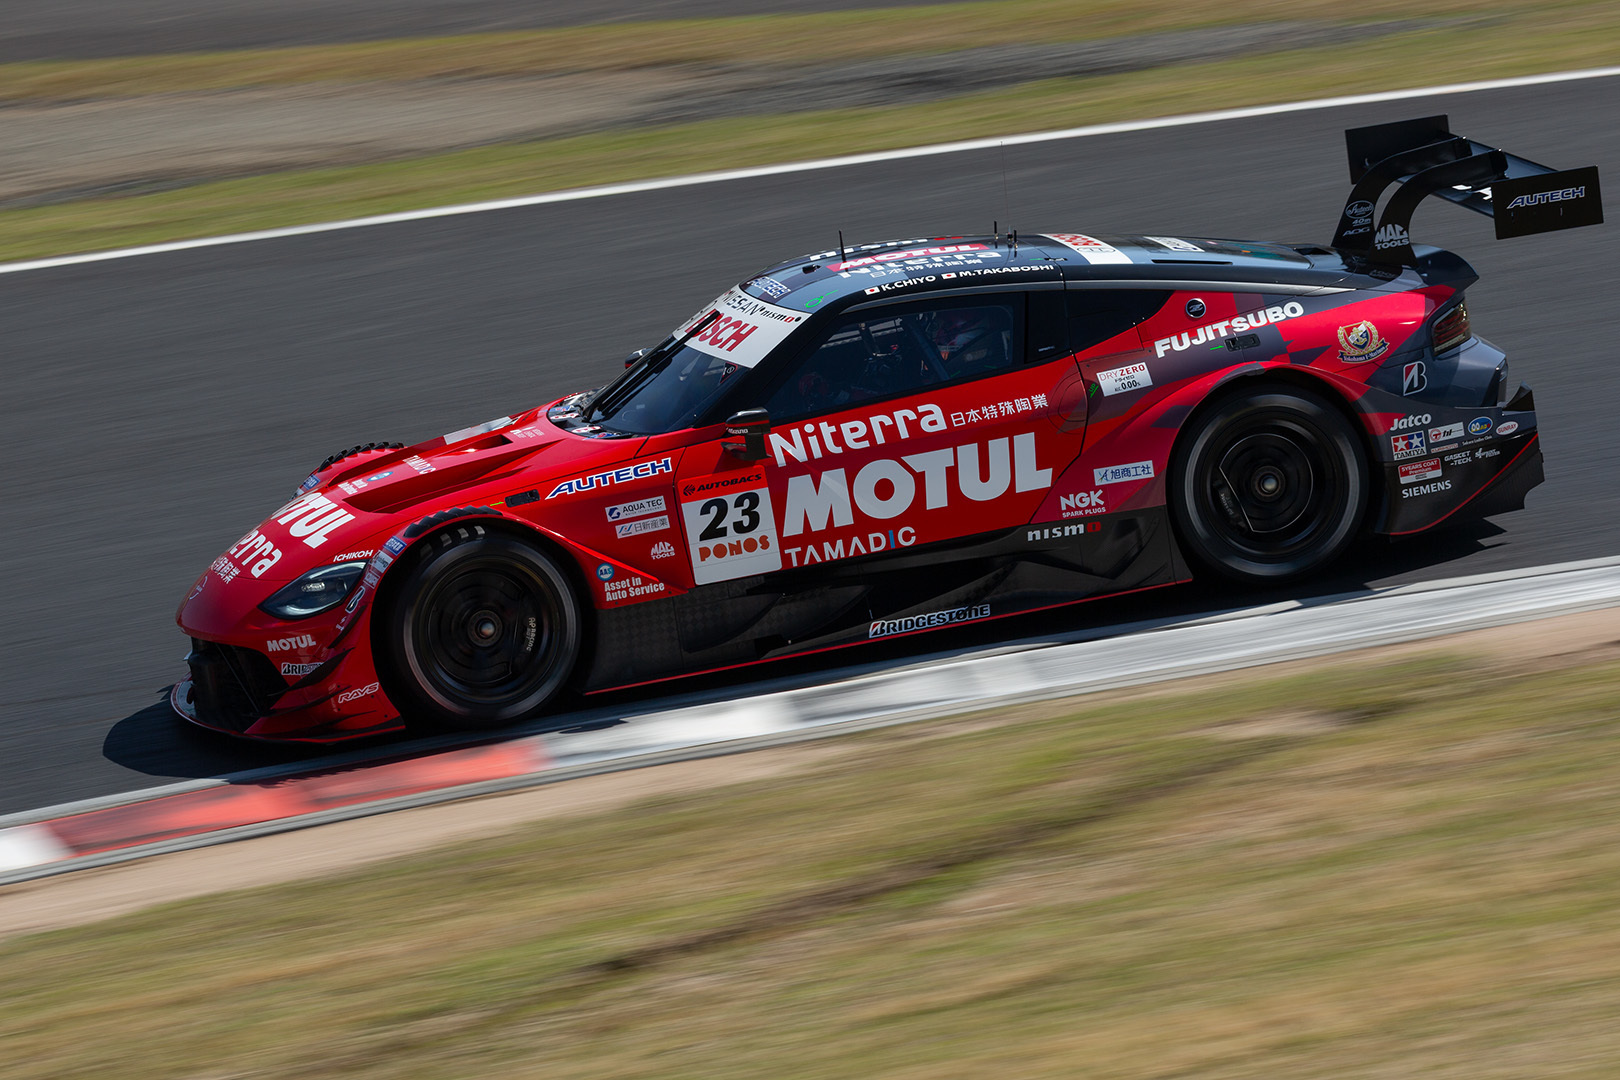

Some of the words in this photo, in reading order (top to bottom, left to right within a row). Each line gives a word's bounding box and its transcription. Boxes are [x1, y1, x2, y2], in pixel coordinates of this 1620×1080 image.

[1507, 186, 1585, 209] AUTECH
[1375, 224, 1409, 244] MAC
[1375, 239, 1410, 250] TOOLS
[839, 243, 980, 269] MOTUL
[881, 275, 937, 291] K.CHIYO
[959, 265, 1055, 278] M.TAKABOSHI
[1154, 301, 1304, 358] FUJITSUBO
[769, 403, 947, 467] Niterra
[951, 393, 1048, 427] 日本特殊陶業
[1390, 413, 1432, 431] Jatco
[1394, 448, 1426, 460] TAMIYA
[545, 457, 672, 500] AUTECH
[696, 473, 762, 492] AUTOBACS
[1110, 465, 1152, 480] 旭商工社
[783, 432, 1053, 537] MOTUL
[1402, 480, 1452, 499] SIEMENS
[622, 502, 646, 513] AQUA
[1060, 489, 1105, 510] NGK
[271, 490, 355, 549] OTUL
[699, 491, 761, 542] 23
[1062, 510, 1084, 518] SPARK
[1085, 507, 1106, 515] PLUGS
[1027, 521, 1101, 542] nismo
[333, 550, 373, 562] ICHIKOH
[651, 541, 675, 555] MAC
[651, 551, 675, 560] TOOLS
[698, 534, 771, 562] PONOS
[785, 526, 917, 567] TAMADIC
[604, 579, 630, 591] Asset
[631, 577, 642, 586] in
[606, 590, 627, 601] Auto
[629, 583, 665, 597] Service
[869, 604, 990, 638] BRIDGESTONE
[267, 634, 316, 652] MOTUL
[338, 682, 379, 703] RAYS
